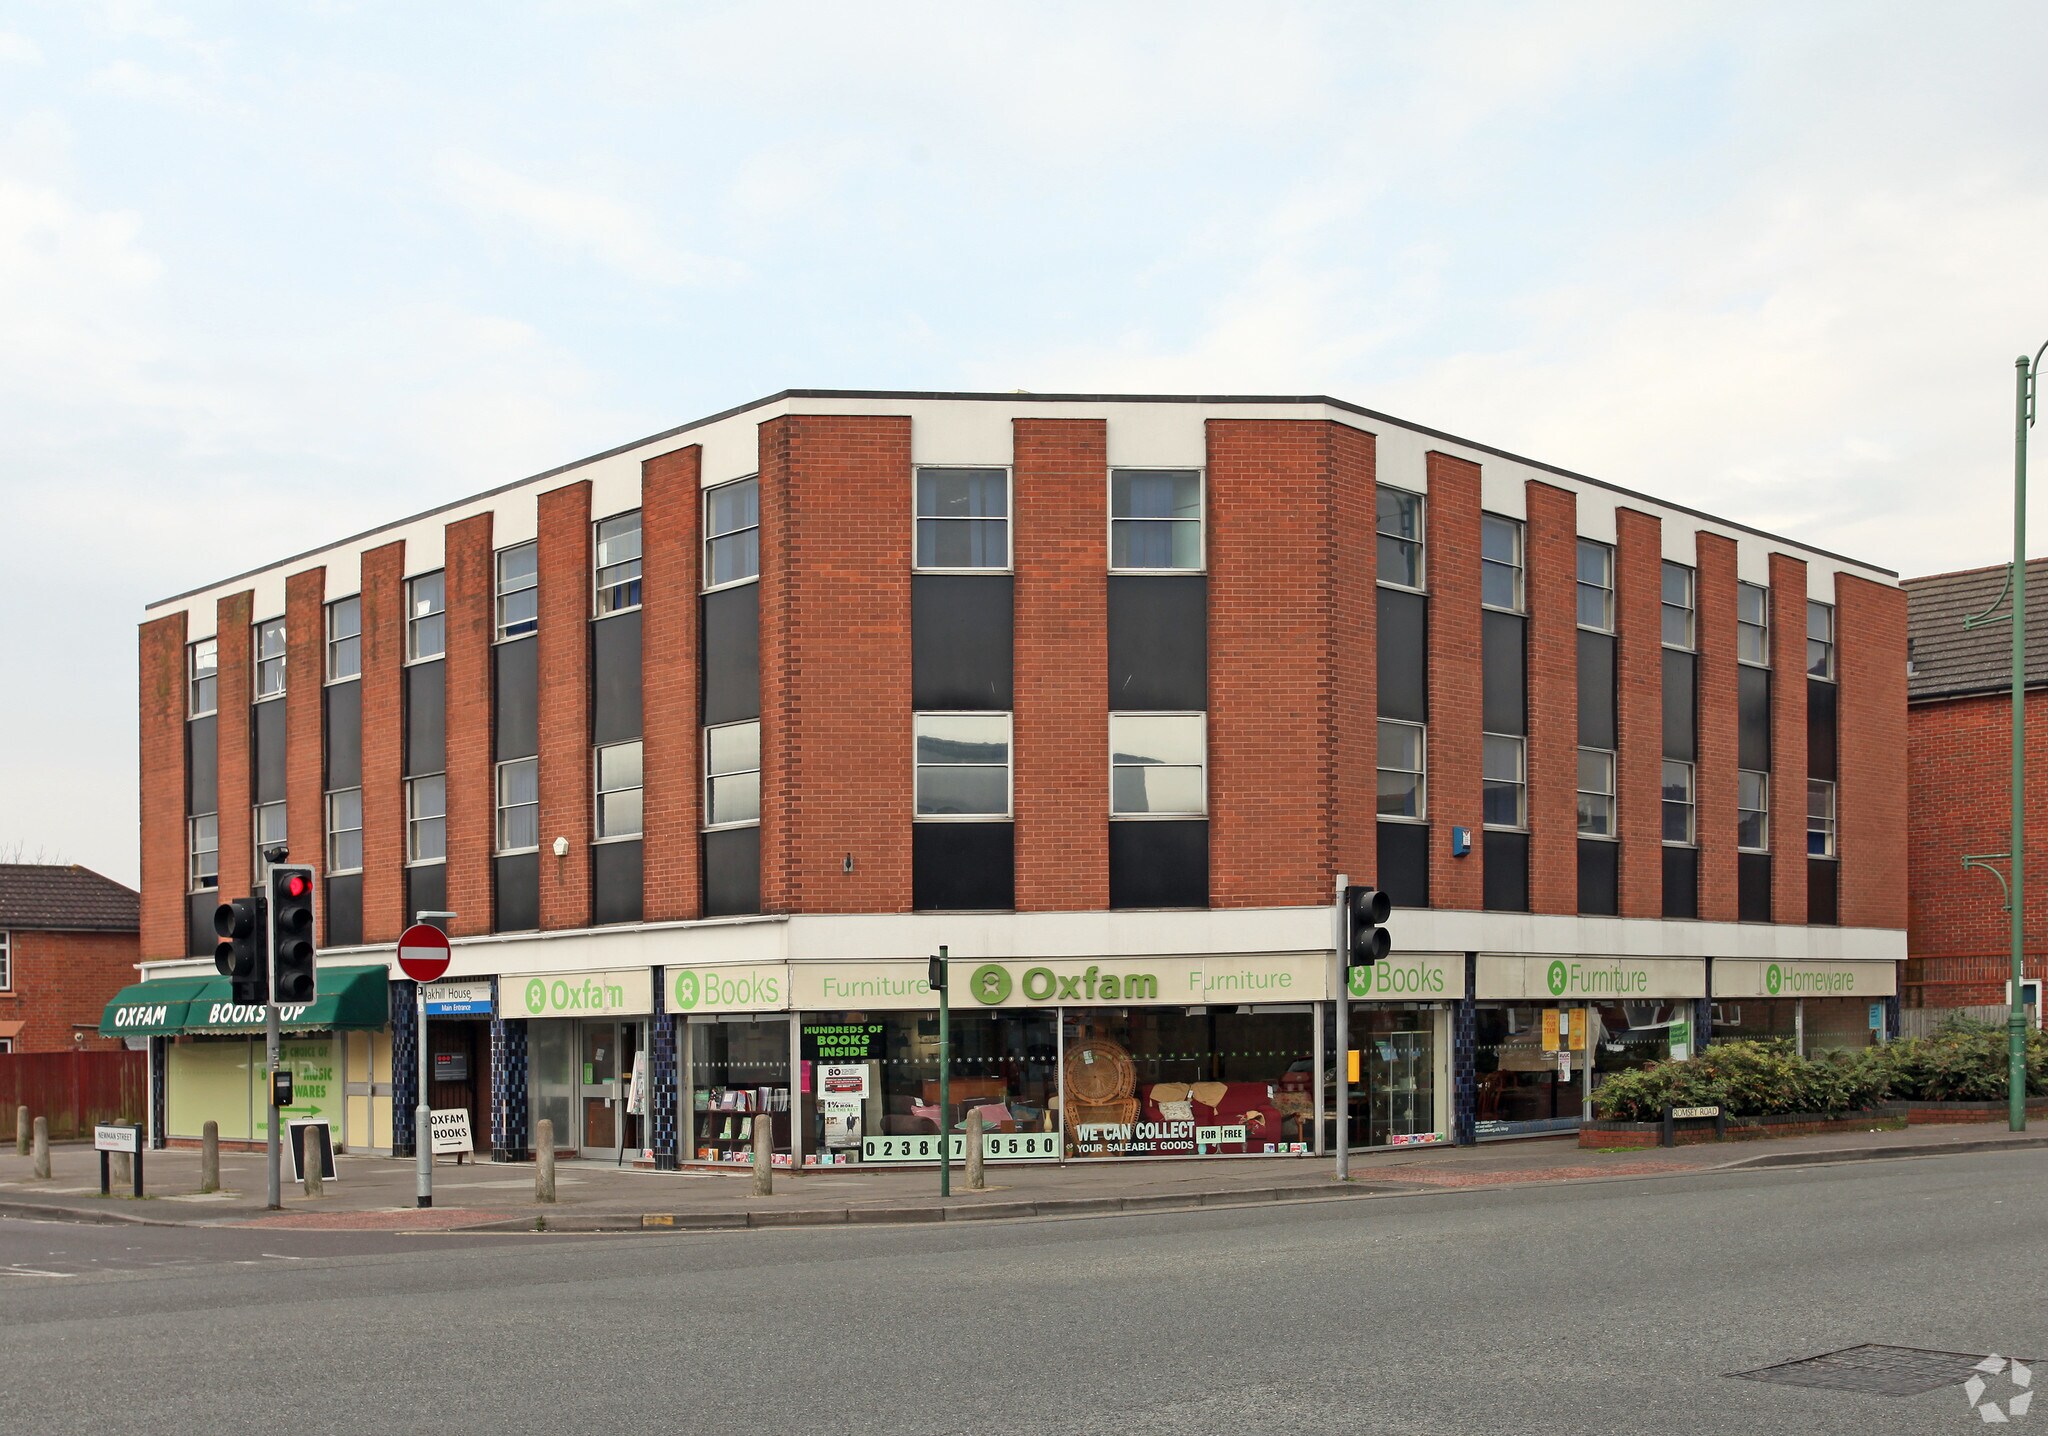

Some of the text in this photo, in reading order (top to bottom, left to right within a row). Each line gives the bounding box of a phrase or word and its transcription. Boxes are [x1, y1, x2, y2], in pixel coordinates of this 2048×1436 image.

[1021, 965, 1159, 1001] Oxfam
[1189, 970, 1292, 991] Furniture
[1376, 961, 1444, 994] Books
[1570, 964, 1648, 993] Furniture
[1783, 966, 1855, 991] Homeware
[550, 978, 624, 1011] Oxfam
[704, 971, 780, 1006] Books
[823, 977, 930, 998] Furniture
[208, 1003, 305, 1024] BOOKSOP
[441, 1004, 453, 1012] Main
[114, 1005, 168, 1027] OXFAM
[803, 1025, 883, 1034] HUNDREDS OF
[816, 1034, 871, 1046] BOOKS
[289, 1046, 315, 1057] CHOICE
[318, 1046, 329, 1057] OF
[819, 1046, 869, 1057] INSIDE
[303, 1067, 333, 1081] MUSIC
[828, 1068, 841, 1076] 80
[1699, 1107, 1718, 1115] ROAD
[430, 1114, 465, 1125] OXFAM
[98, 1131, 132, 1141] NEWMAN STREET
[433, 1128, 467, 1139] BOOKS
[1076, 1121, 1242, 1141] WE CAN COLLECT FOR FREE
[1077, 1140, 1194, 1153] YOUR SALEABLE GOODS
